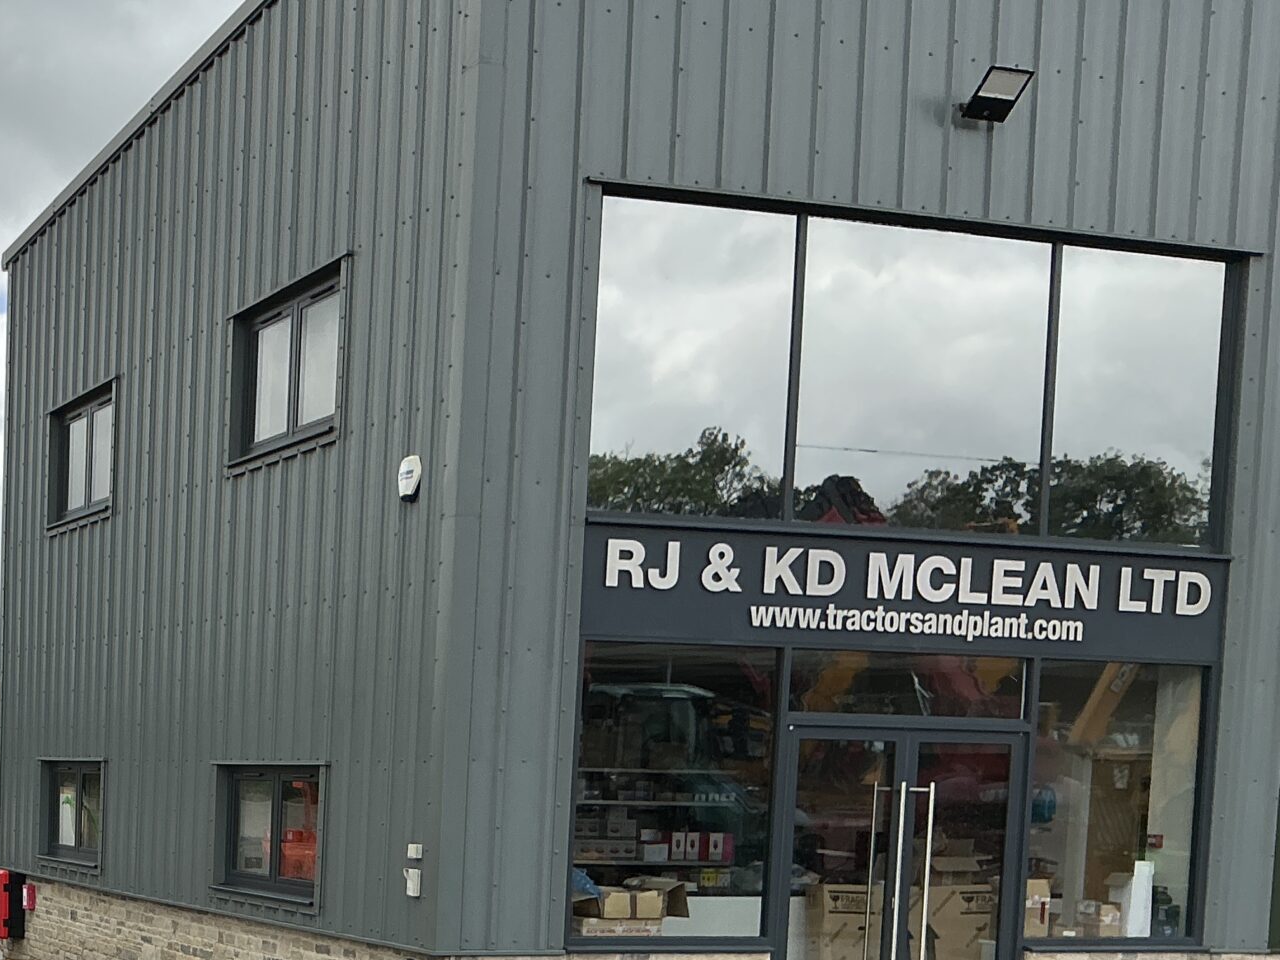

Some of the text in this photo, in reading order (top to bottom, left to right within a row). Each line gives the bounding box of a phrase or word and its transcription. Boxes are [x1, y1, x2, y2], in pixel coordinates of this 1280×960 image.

[604, 538, 1213, 617] RJ & KD MCLEAN LTD
[750, 603, 1084, 642] www.tractorsandplant.com
